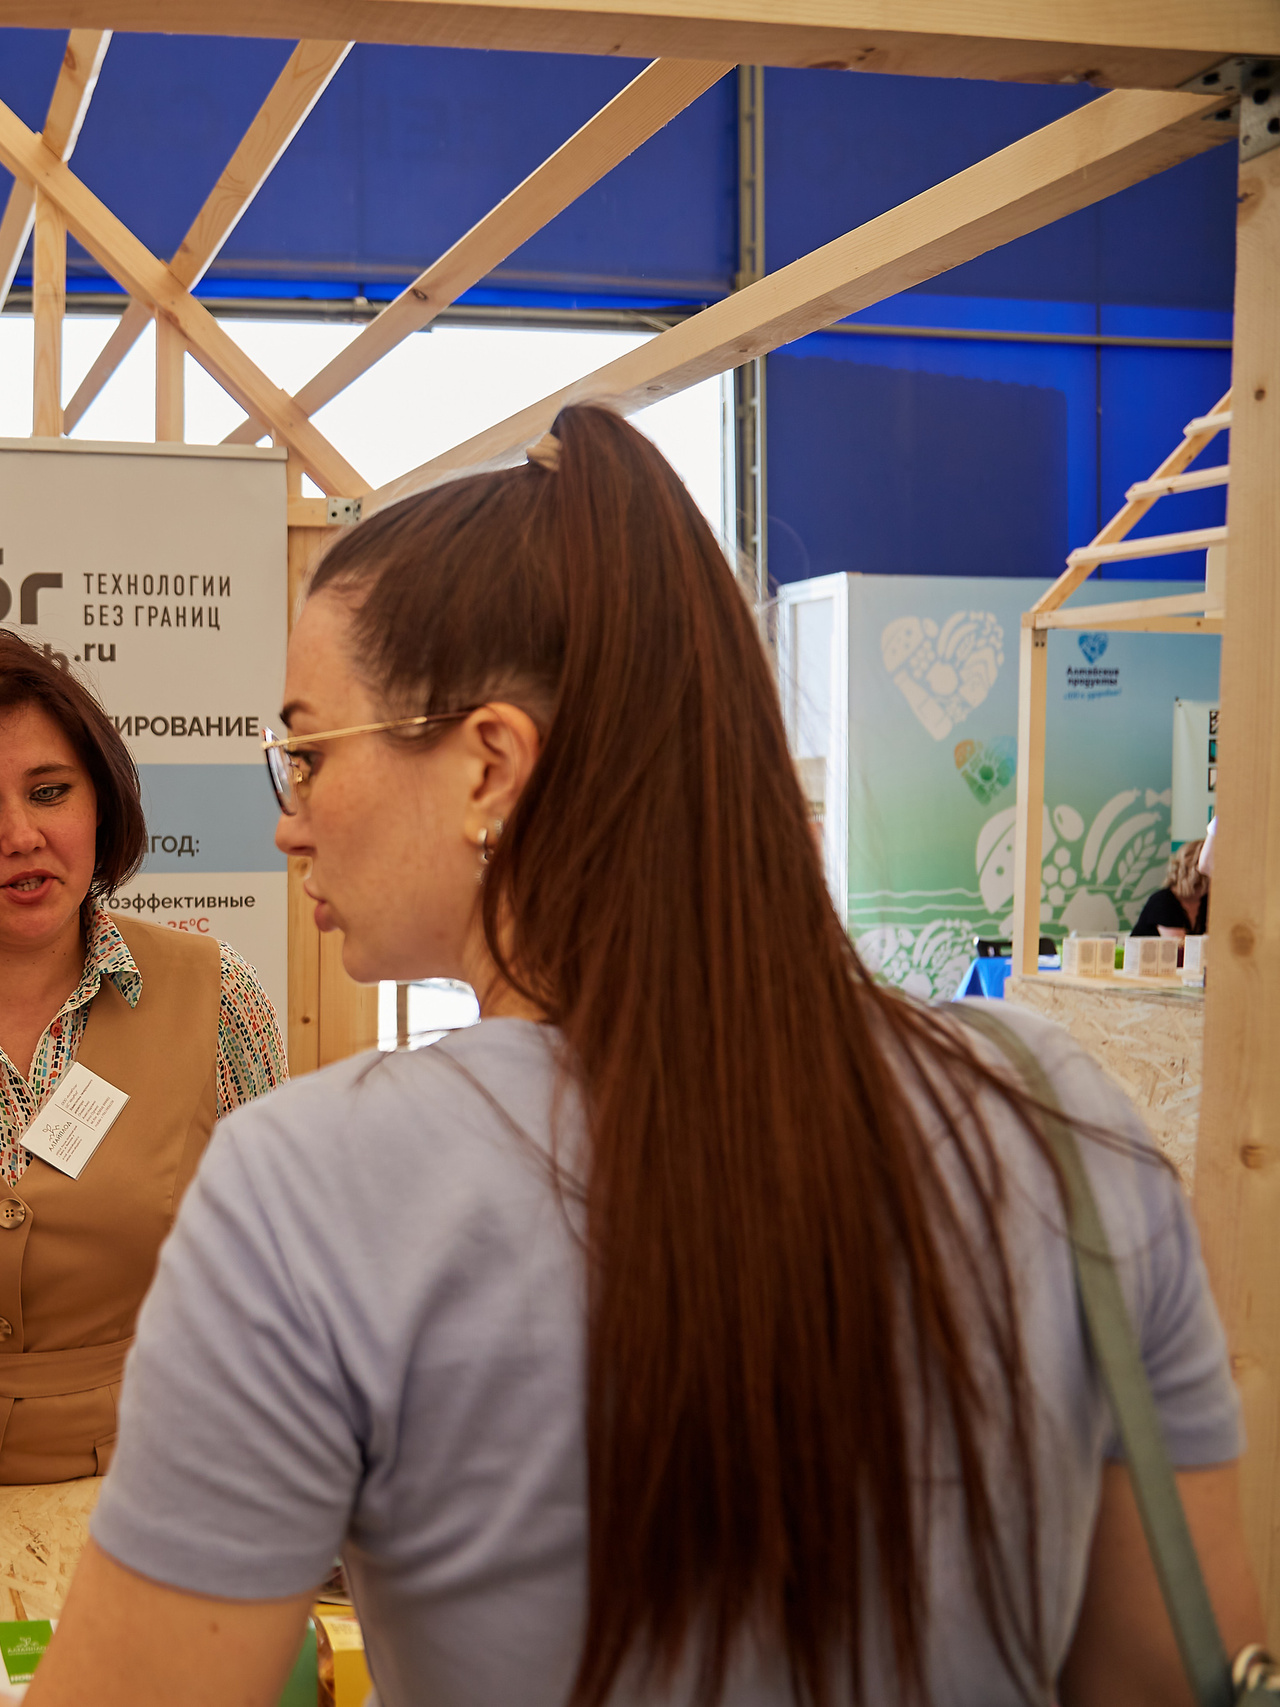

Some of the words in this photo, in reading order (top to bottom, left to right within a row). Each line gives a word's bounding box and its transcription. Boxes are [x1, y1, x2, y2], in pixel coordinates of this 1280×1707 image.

[83, 572, 232, 597] ТЕХНОЛОГИИ
[83, 605, 124, 627] БЕЗ
[134, 606, 221, 630] ГРАНИЦ
[144, 835, 200, 857] ГОД:
[101, 893, 256, 914] гоэффективные
